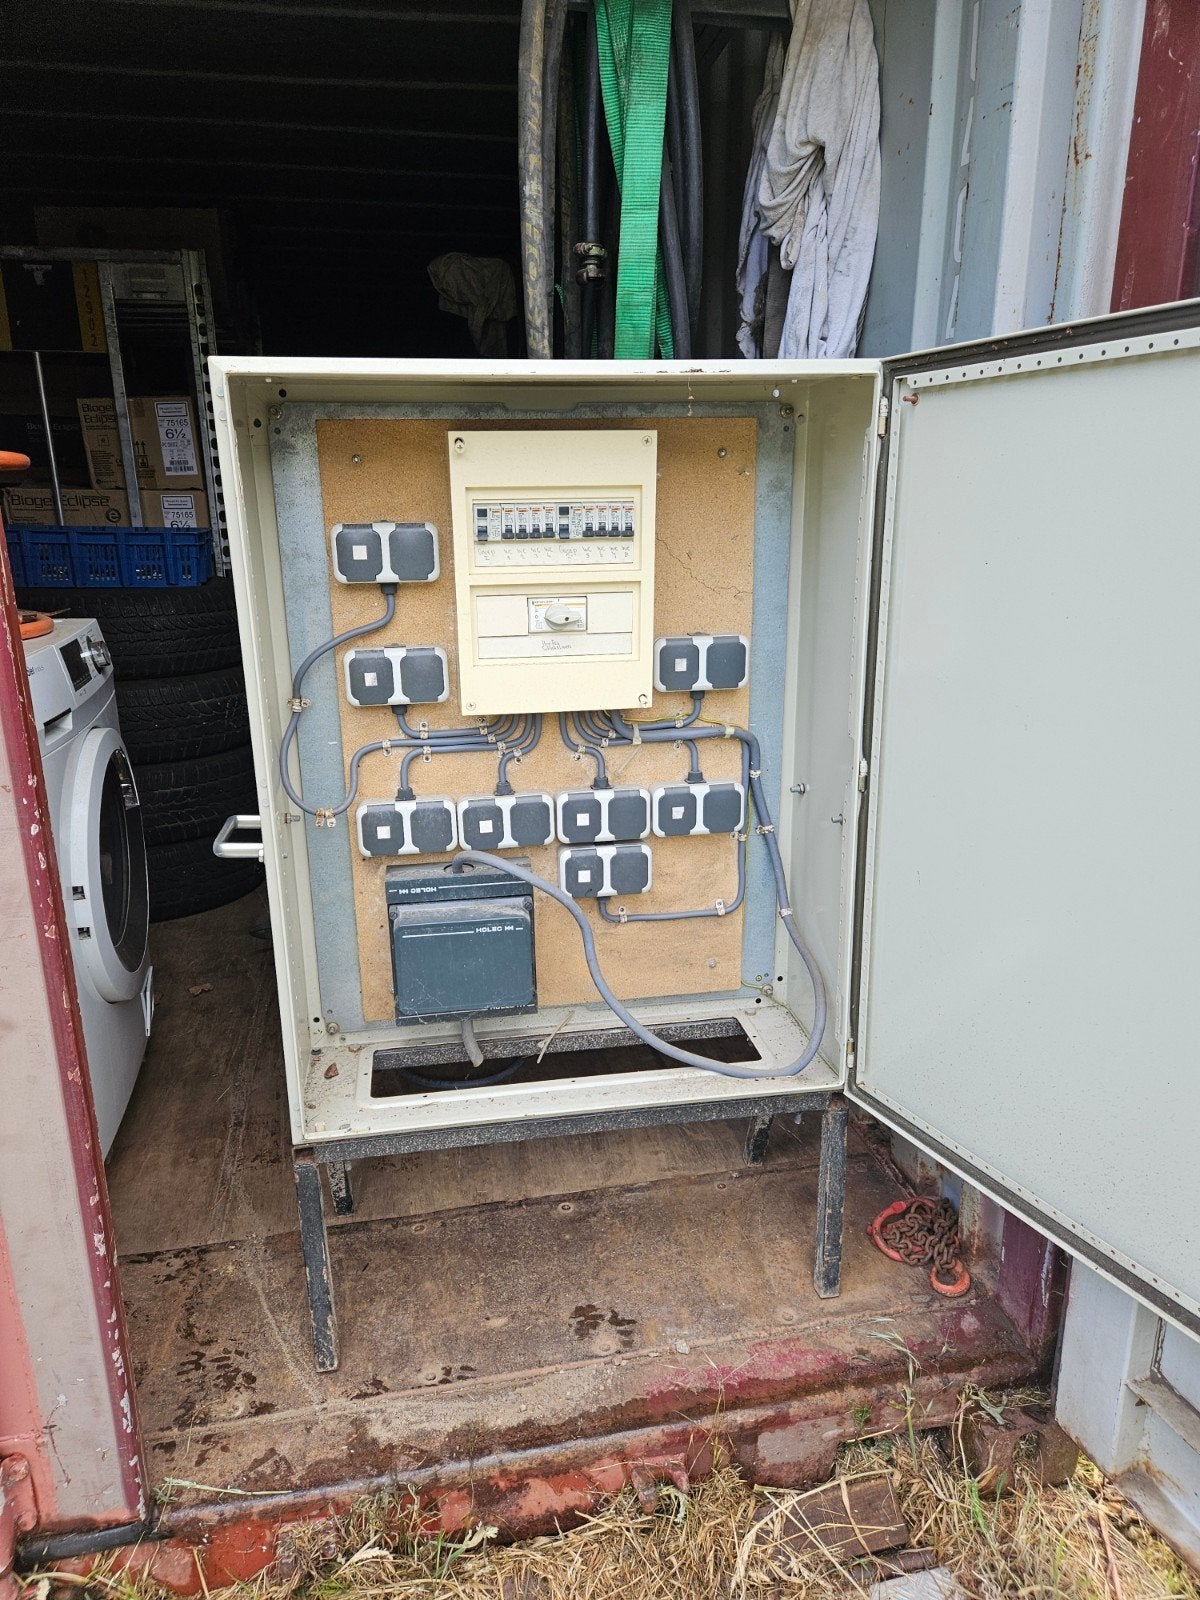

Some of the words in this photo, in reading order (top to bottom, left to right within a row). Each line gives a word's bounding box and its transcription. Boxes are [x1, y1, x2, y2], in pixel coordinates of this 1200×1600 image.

[166, 419, 189, 427] 75165
[171, 511, 194, 519] 75165
[410, 886, 437, 894] HOLEC
[475, 926, 503, 934] HOLEC
